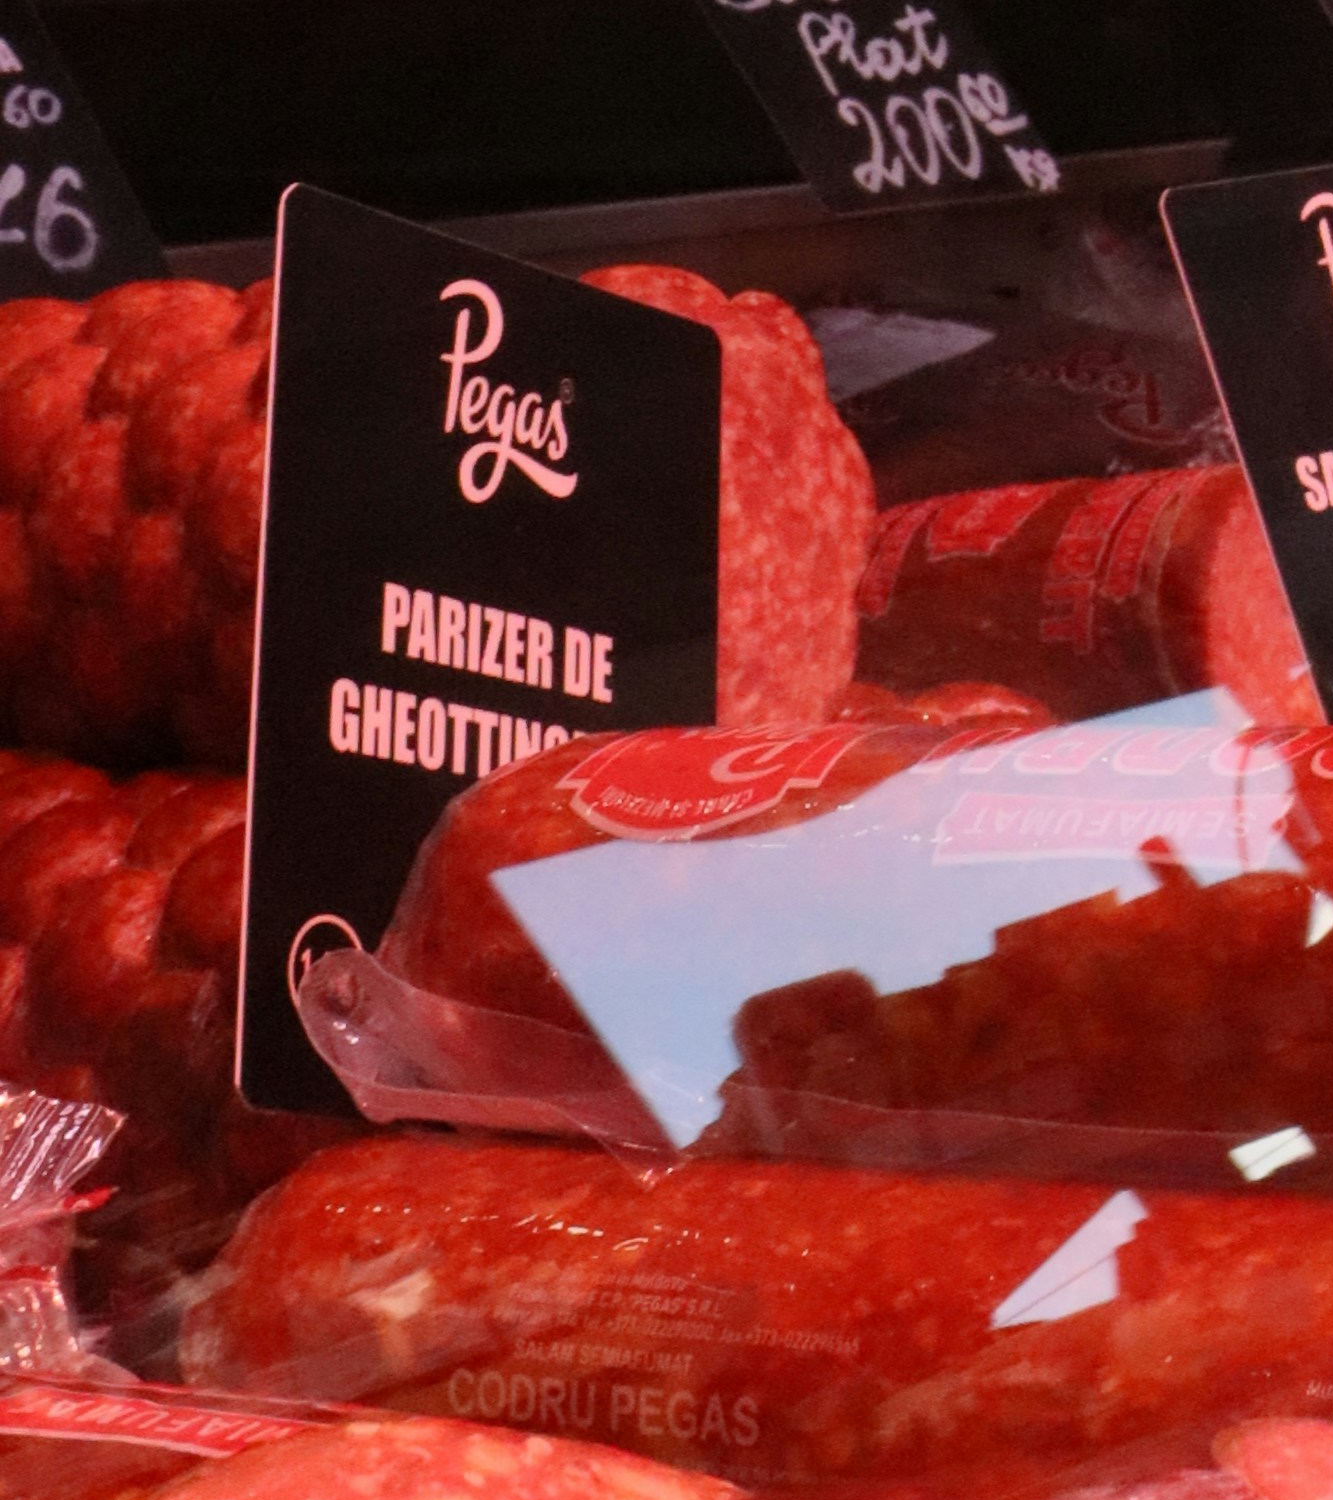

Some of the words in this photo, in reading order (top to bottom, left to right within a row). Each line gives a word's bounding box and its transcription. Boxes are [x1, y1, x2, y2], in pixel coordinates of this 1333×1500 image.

[4, 83, 62, 129] 60
[837, 87, 982, 193] 200
[440, 278, 578, 505] Pegas
[382, 582, 552, 692] PARIZER
[564, 632, 615, 705] DE
[967, 805, 1260, 845] SEMIAFUMAT
[447, 1367, 601, 1428] CODRU
[610, 1385, 760, 1450] PEGAS
